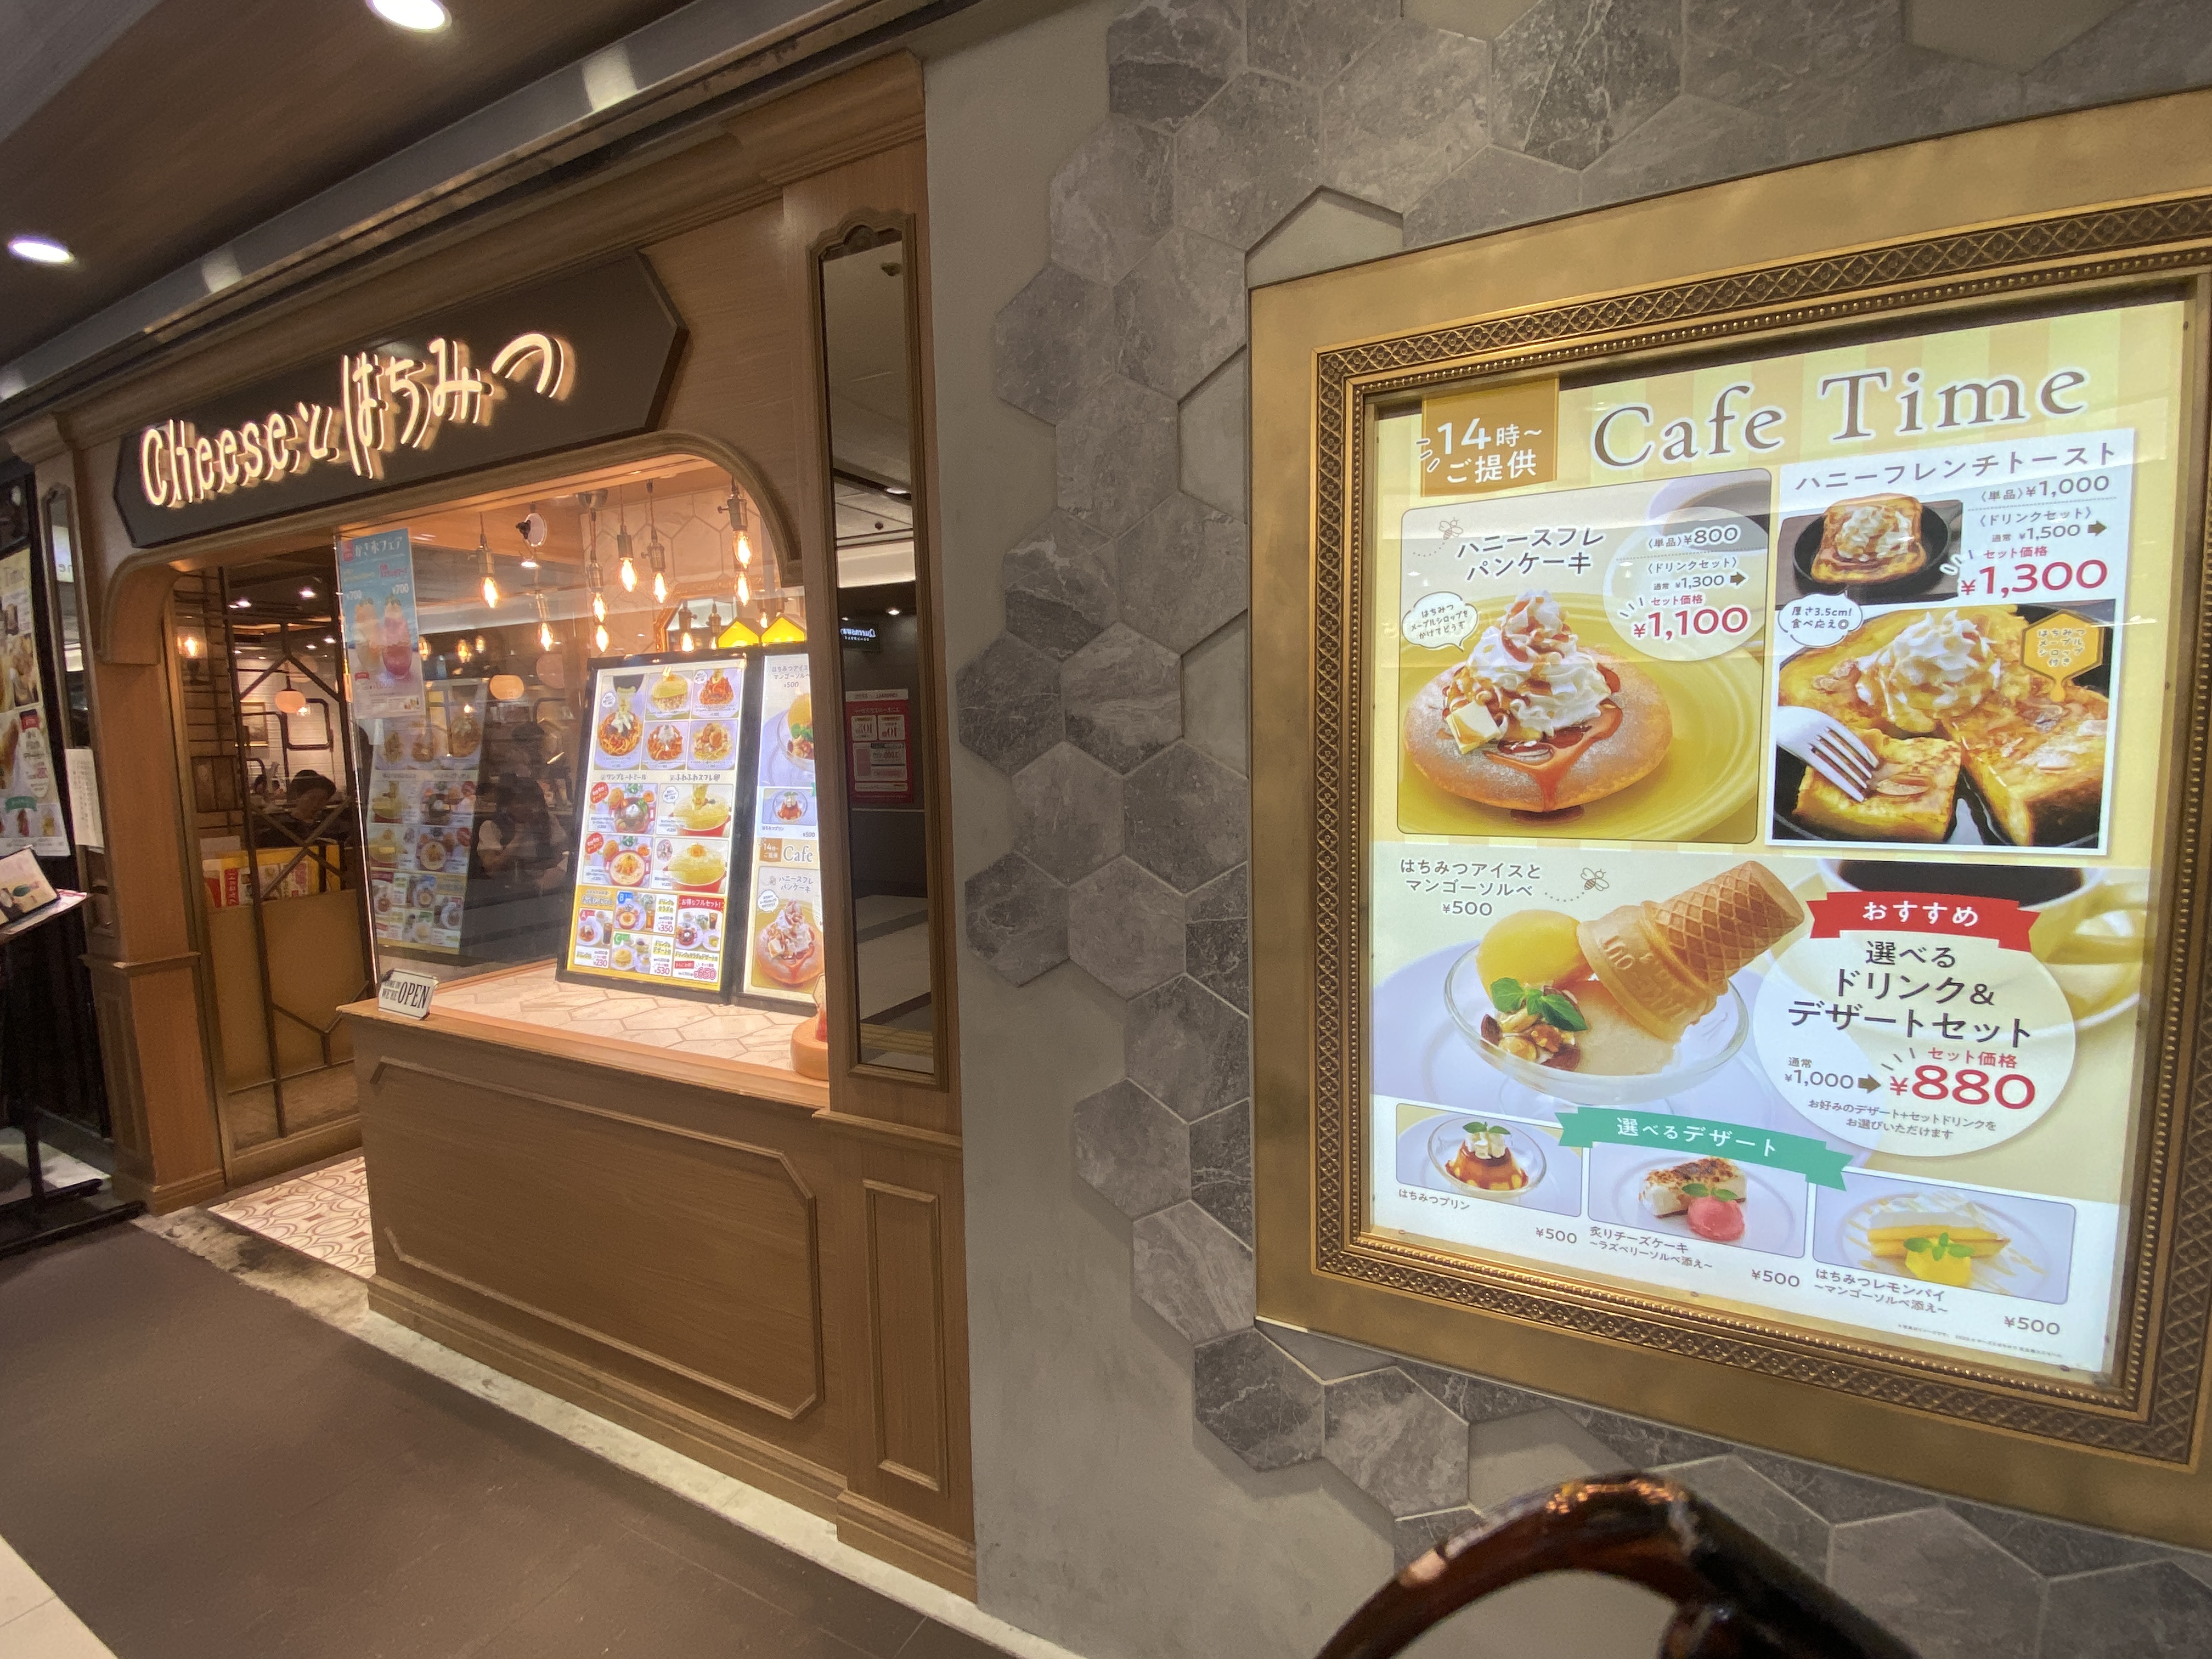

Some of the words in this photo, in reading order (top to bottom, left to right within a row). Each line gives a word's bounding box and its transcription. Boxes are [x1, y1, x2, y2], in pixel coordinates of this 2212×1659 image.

[1595, 386, 1783, 466] Cafe
[1822, 369, 2086, 439] Time
[1447, 448, 1536, 483] ご提供
[1796, 442, 2115, 490] ハニーフレンチトースト
[1457, 528, 1604, 557] ハニースフレ
[2019, 524, 2081, 541] ¥1,500
[1983, 545, 2048, 559] セット価格
[1466, 552, 1591, 580] パンケーキ
[1675, 575, 1724, 589] ¥1,300
[1960, 559, 2108, 598] ¥1,300
[1651, 594, 1703, 606] セット価格
[1411, 610, 1468, 631] メープルシロップを
[1421, 605, 1454, 618] はちみつ
[1633, 607, 1748, 640] ¥1,100
[783, 845, 813, 862] Cafe
[1401, 859, 1541, 879] はちみつアイスと
[1406, 879, 1533, 896] マンゴーソルベ
[1442, 900, 1493, 916] ¥500
[1862, 900, 1978, 927] おすすめ
[1865, 940, 1956, 968] 選べる
[398, 981, 431, 1009] OPEN
[1838, 968, 1995, 1006] ドリンク&
[1788, 1000, 2030, 1048] デザートセット
[1788, 1057, 1813, 1068] 通常
[1928, 1047, 2017, 1069] セット価格
[1784, 1069, 1854, 1089] ¥1,000
[1889, 1064, 2035, 1109] ¥880
[1616, 1117, 1776, 1157] 選べるデザート
[1846, 1117, 1954, 1140] お選びいただけます
[1398, 1188, 1470, 1210] はちみつプリン
[1536, 1227, 1577, 1244] ¥500
[1590, 1226, 1689, 1254] 炙りチーズケーキ
[1751, 1268, 1801, 1288] ¥500
[1815, 1268, 1945, 1302] はちみつレモンパイ
[2004, 1316, 2061, 1335] ¥500
